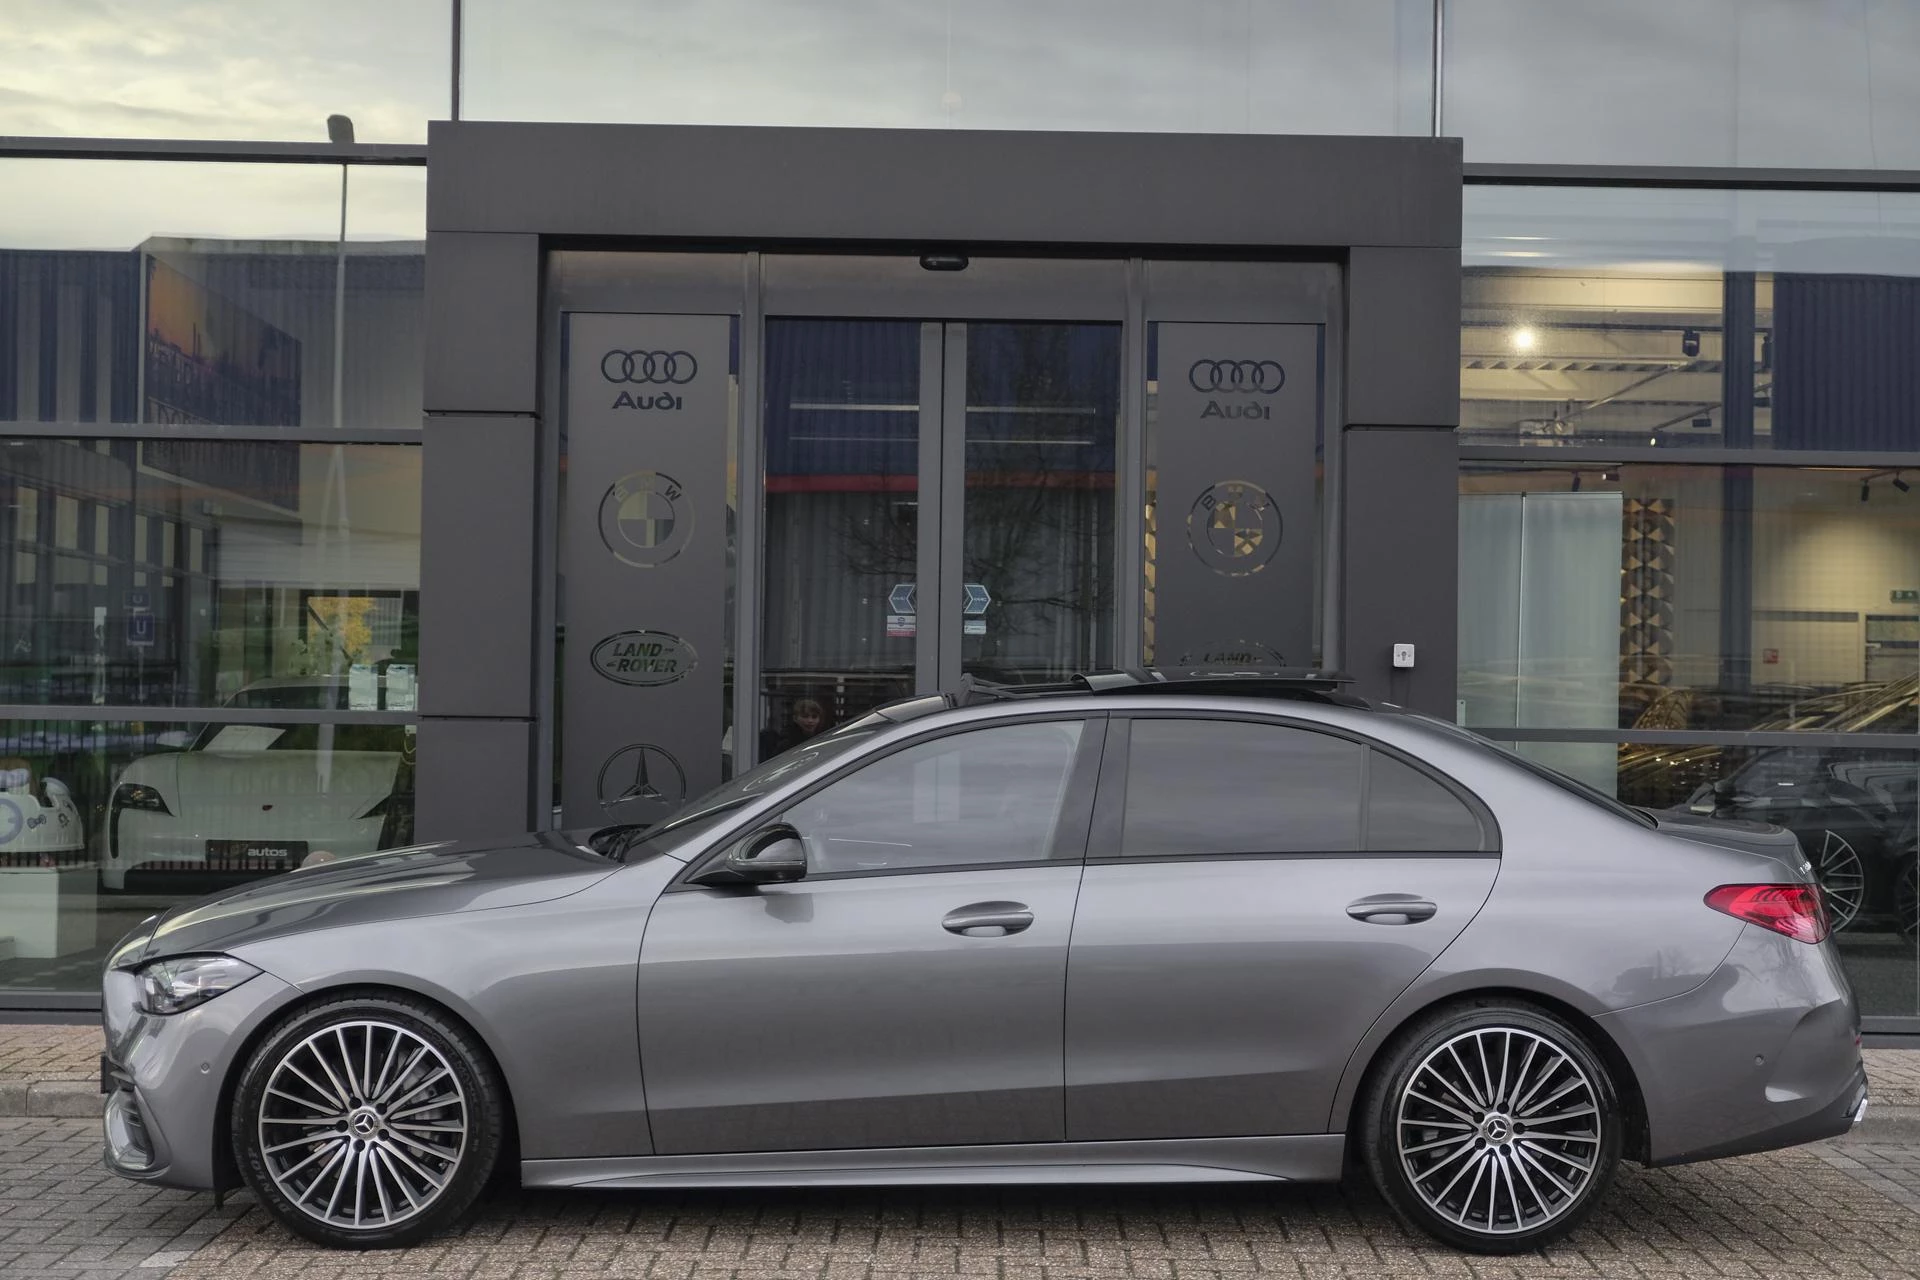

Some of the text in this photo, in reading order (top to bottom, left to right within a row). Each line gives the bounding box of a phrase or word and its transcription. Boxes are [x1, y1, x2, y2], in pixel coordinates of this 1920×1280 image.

[612, 391, 682, 410] Audi
[1200, 400, 1270, 420] Audi
[247, 847, 288, 857] autos
